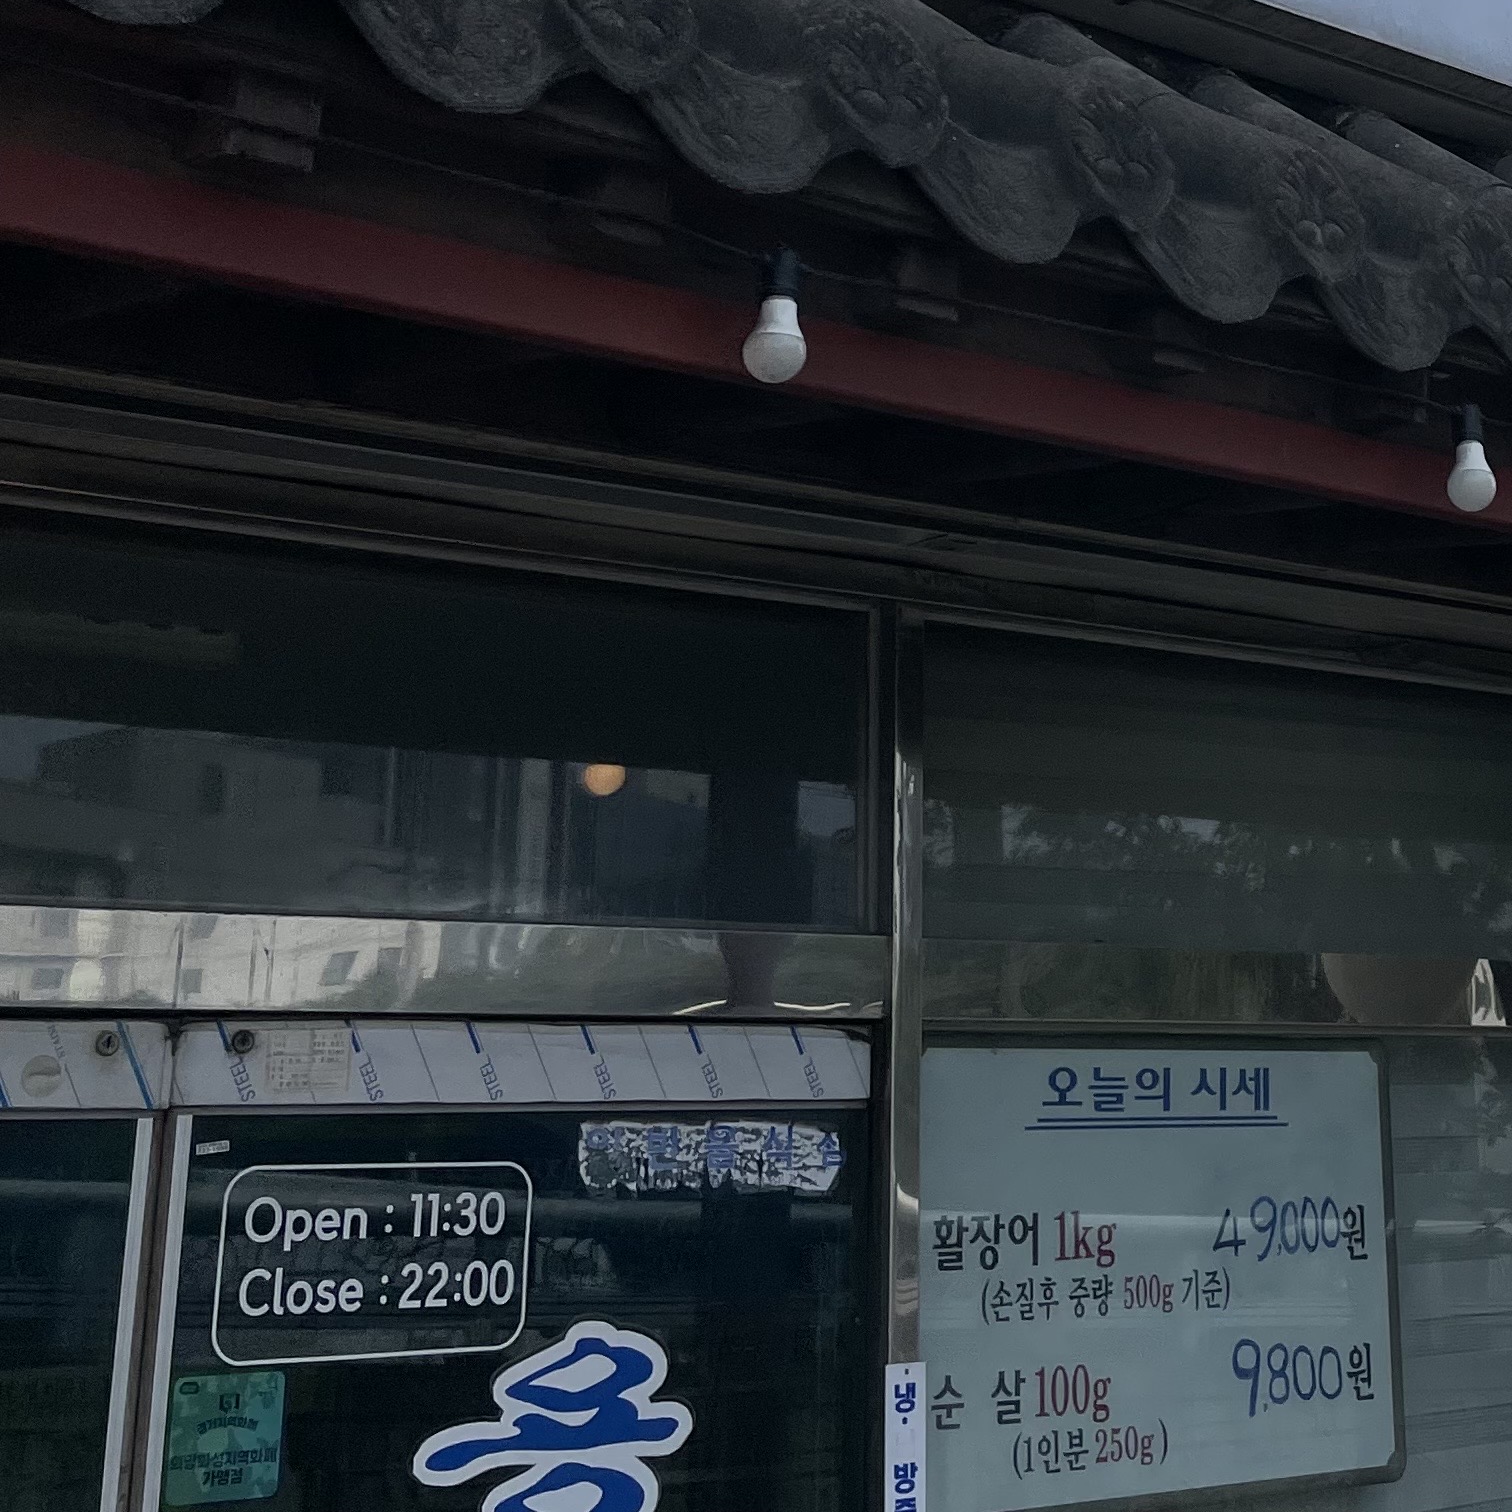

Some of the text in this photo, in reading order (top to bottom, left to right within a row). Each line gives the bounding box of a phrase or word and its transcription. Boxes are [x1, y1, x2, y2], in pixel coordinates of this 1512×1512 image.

[229, 1056, 257, 1102] STEEL
[356, 1055, 385, 1102] STEEL
[478, 1054, 504, 1102] STEEL
[593, 1053, 618, 1101] STEEL
[699, 1052, 724, 1099] STEEL
[803, 1051, 826, 1099] STEEL
[1042, 1066, 1272, 1113] 오늘의 시세
[244, 1194, 369, 1252] Open
[409, 1190, 507, 1238] 11:30
[931, 1211, 1040, 1272] 활장어
[1053, 1210, 1118, 1268] 1kg
[238, 1267, 365, 1317] Close
[398, 1259, 516, 1309] 22:00
[1067, 1273, 1113, 1319] 중량
[1122, 1273, 1175, 1314] 500g
[1033, 1363, 1112, 1424] 100g
